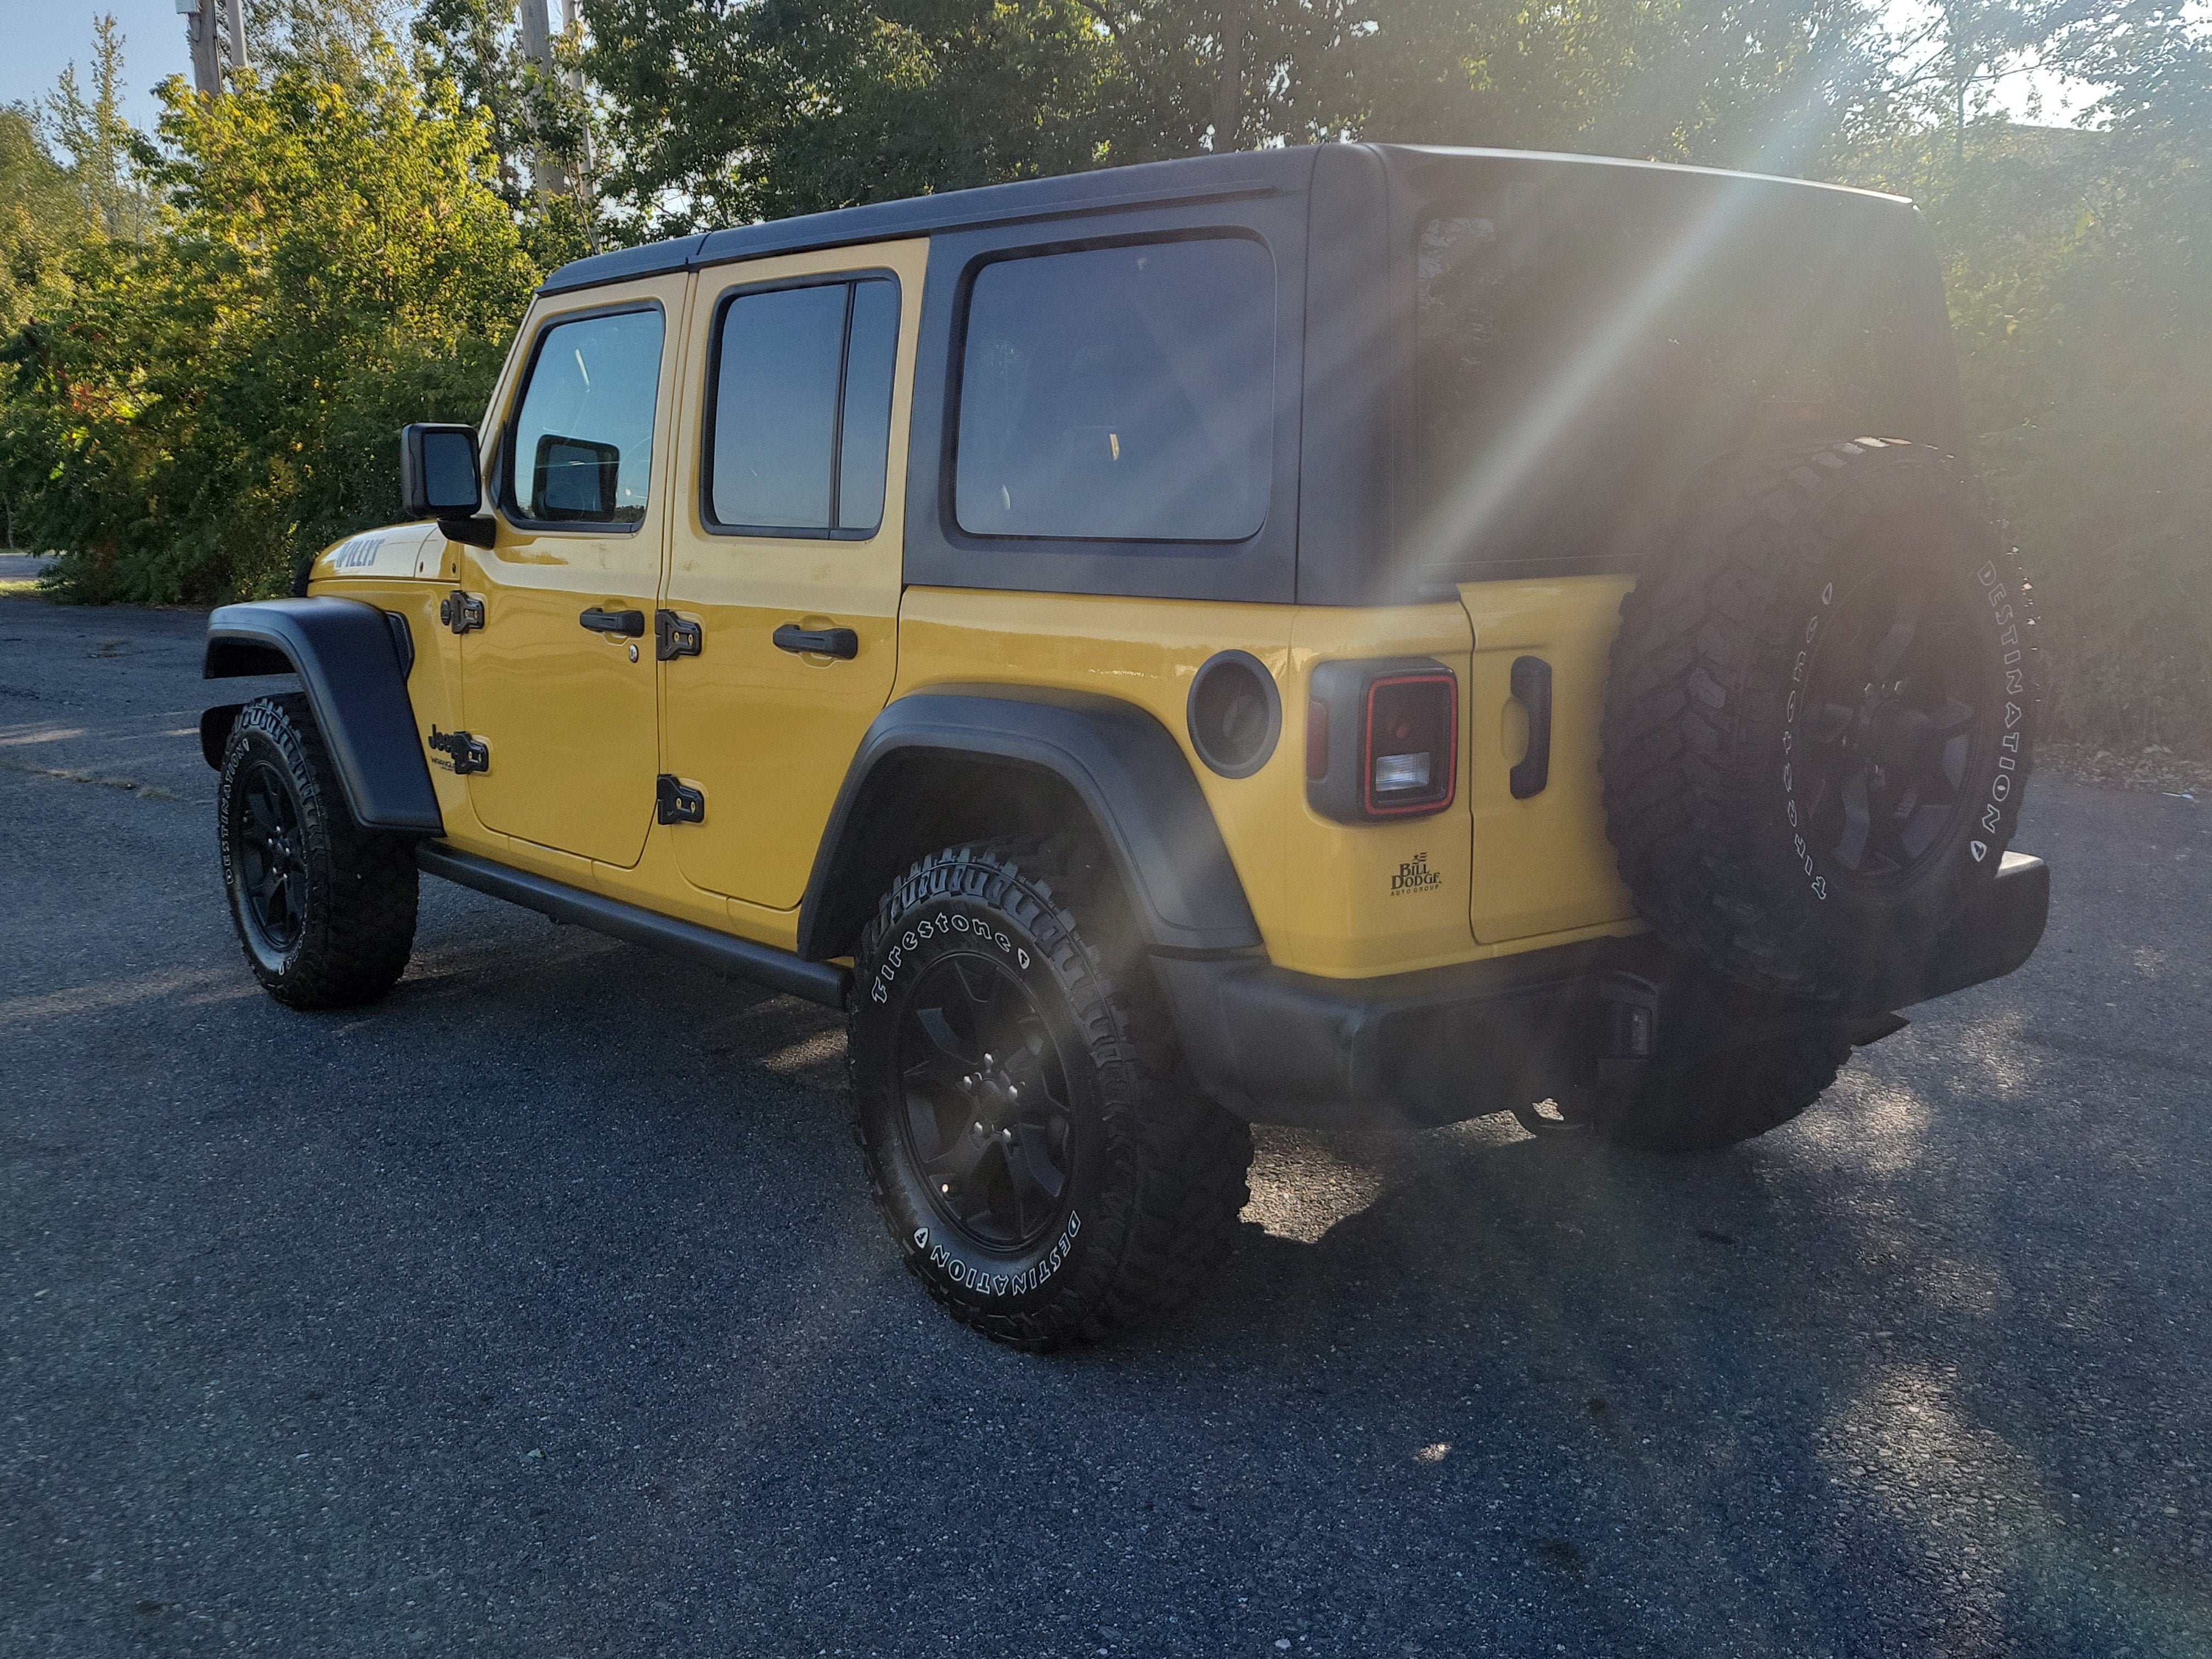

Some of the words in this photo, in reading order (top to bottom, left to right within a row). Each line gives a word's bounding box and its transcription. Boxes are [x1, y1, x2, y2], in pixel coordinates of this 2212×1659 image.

[1977, 560, 2022, 834] DESTINATION
[221, 743, 244, 885] DESTINATION
[1413, 884, 1439, 893] GROUP
[872, 912, 1011, 1003] Firestone
[930, 1209, 1081, 1296] DESTINATION
